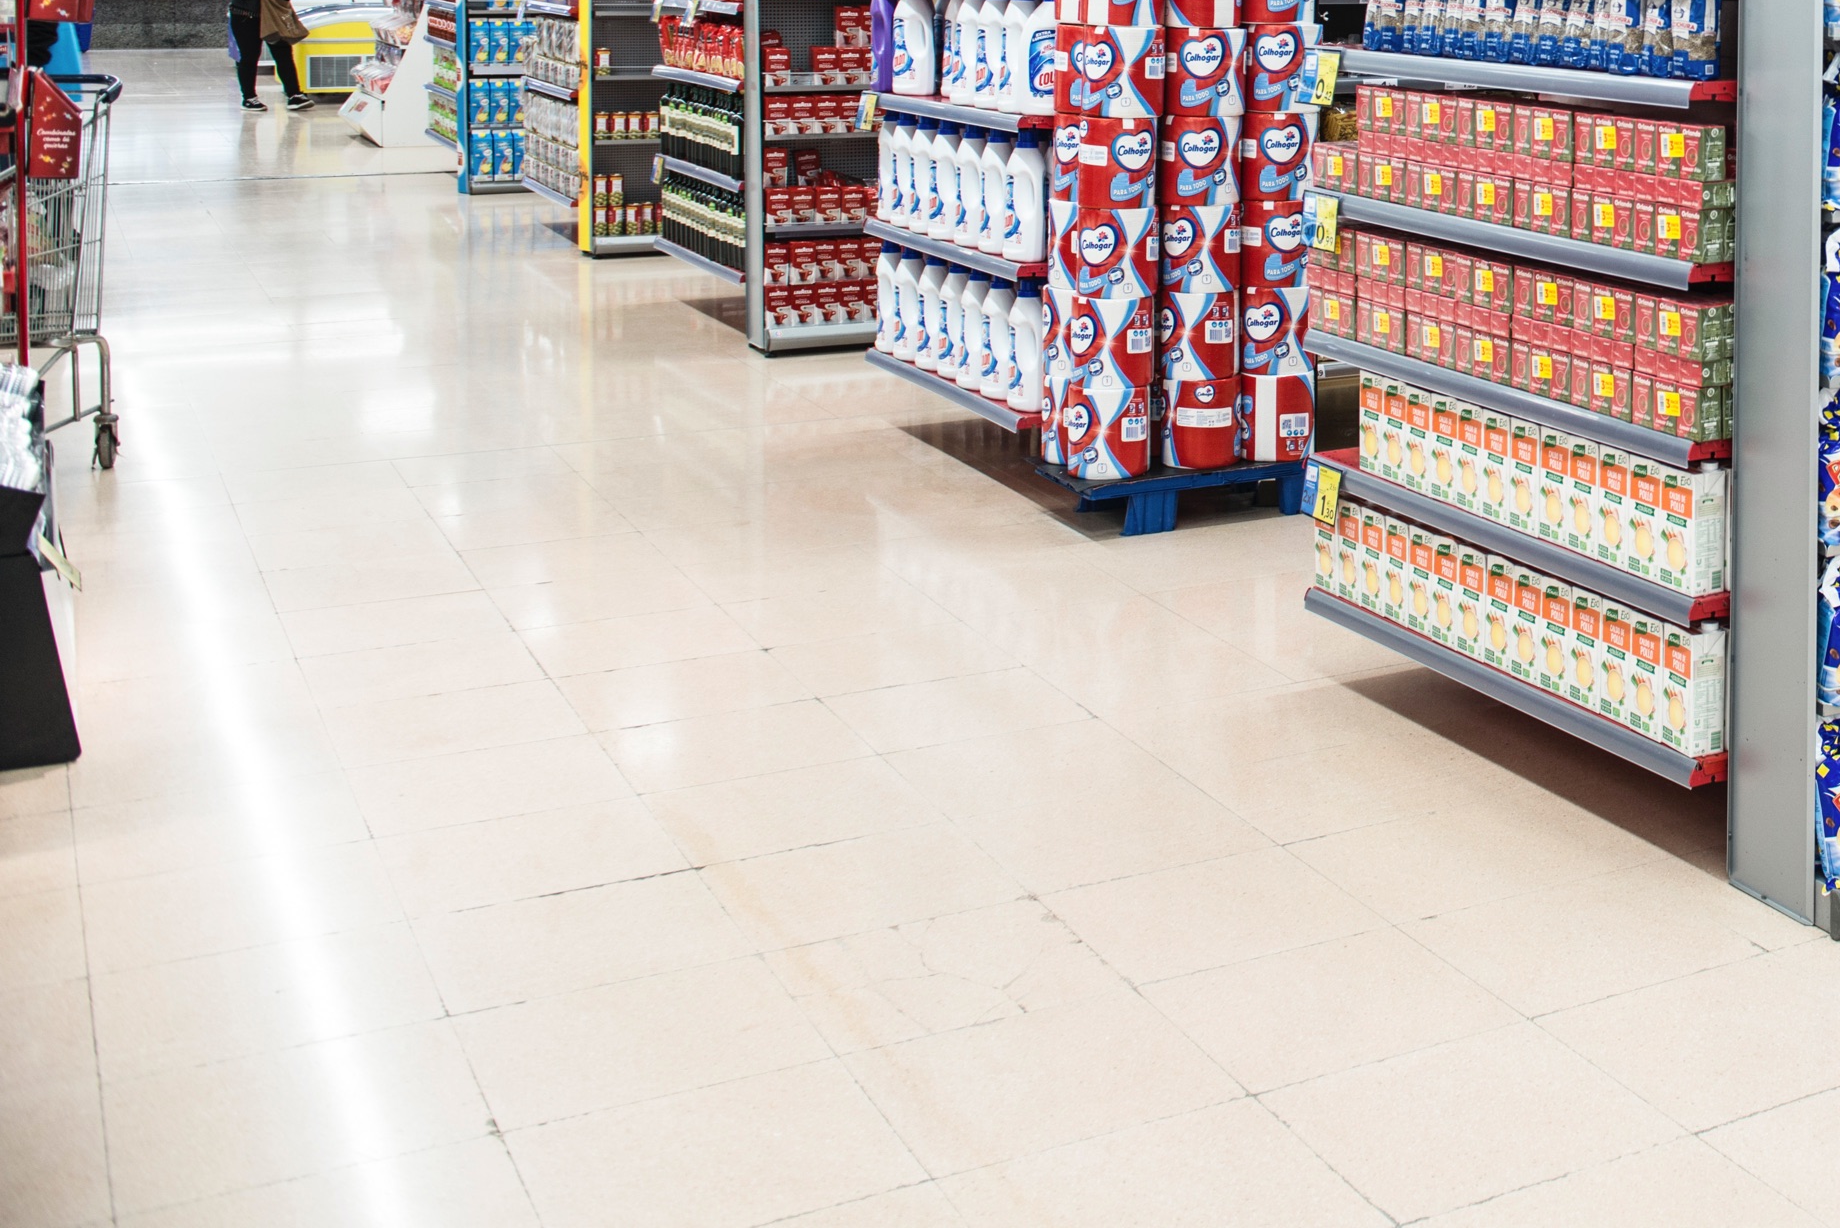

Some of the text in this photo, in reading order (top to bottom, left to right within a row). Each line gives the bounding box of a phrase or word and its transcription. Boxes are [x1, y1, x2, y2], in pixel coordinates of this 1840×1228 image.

[1185, 49, 1220, 63] Colhogar
[1258, 45, 1293, 58] Colhogar
[1039, 72, 1055, 86] COL
[1117, 144, 1150, 157] Colhogar
[1183, 142, 1218, 156] Colhogar
[1265, 139, 1300, 152] Colhogar
